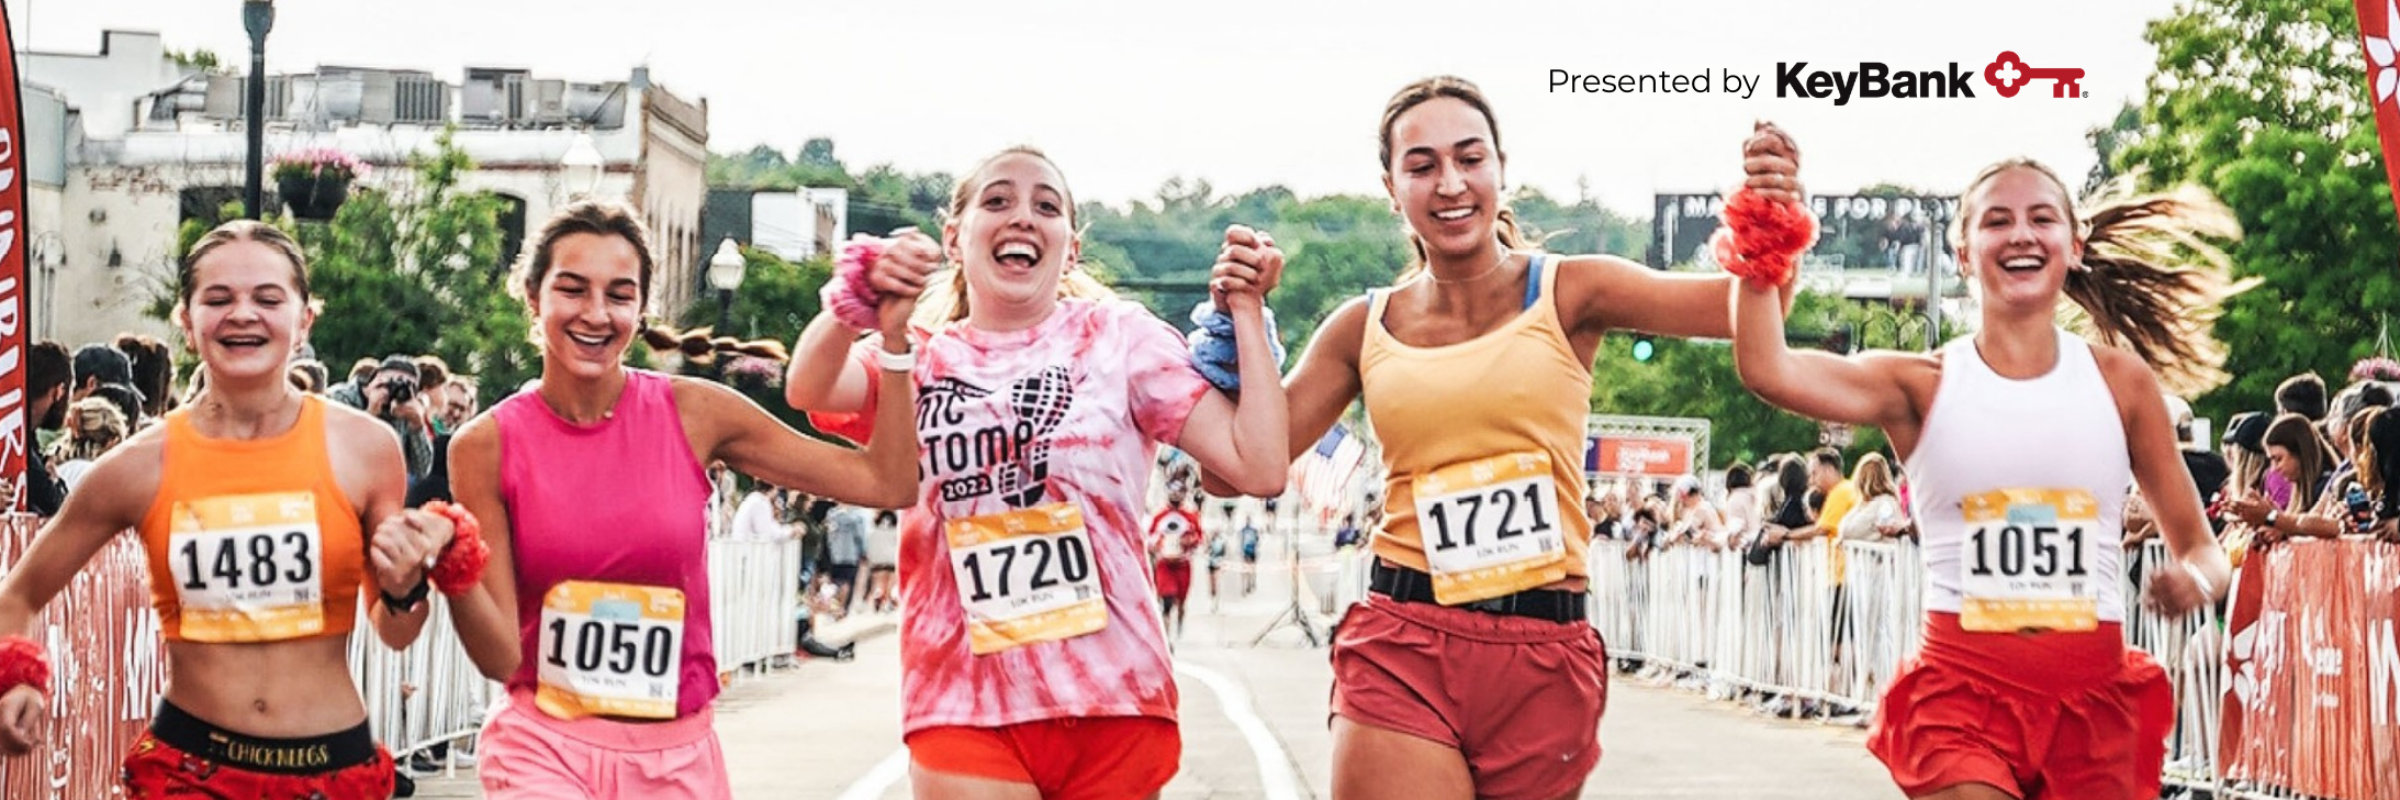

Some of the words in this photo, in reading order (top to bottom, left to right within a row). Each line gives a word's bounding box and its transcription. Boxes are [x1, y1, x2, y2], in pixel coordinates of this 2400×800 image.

[1834, 196, 1886, 221] FOR
[918, 420, 1033, 484] TOMP
[943, 476, 991, 501] 2022
[1429, 482, 1551, 552] 1721
[181, 531, 312, 590] 1483
[963, 535, 1088, 603] 1720
[1971, 526, 2088, 576] 1051
[547, 617, 672, 677] 1050
